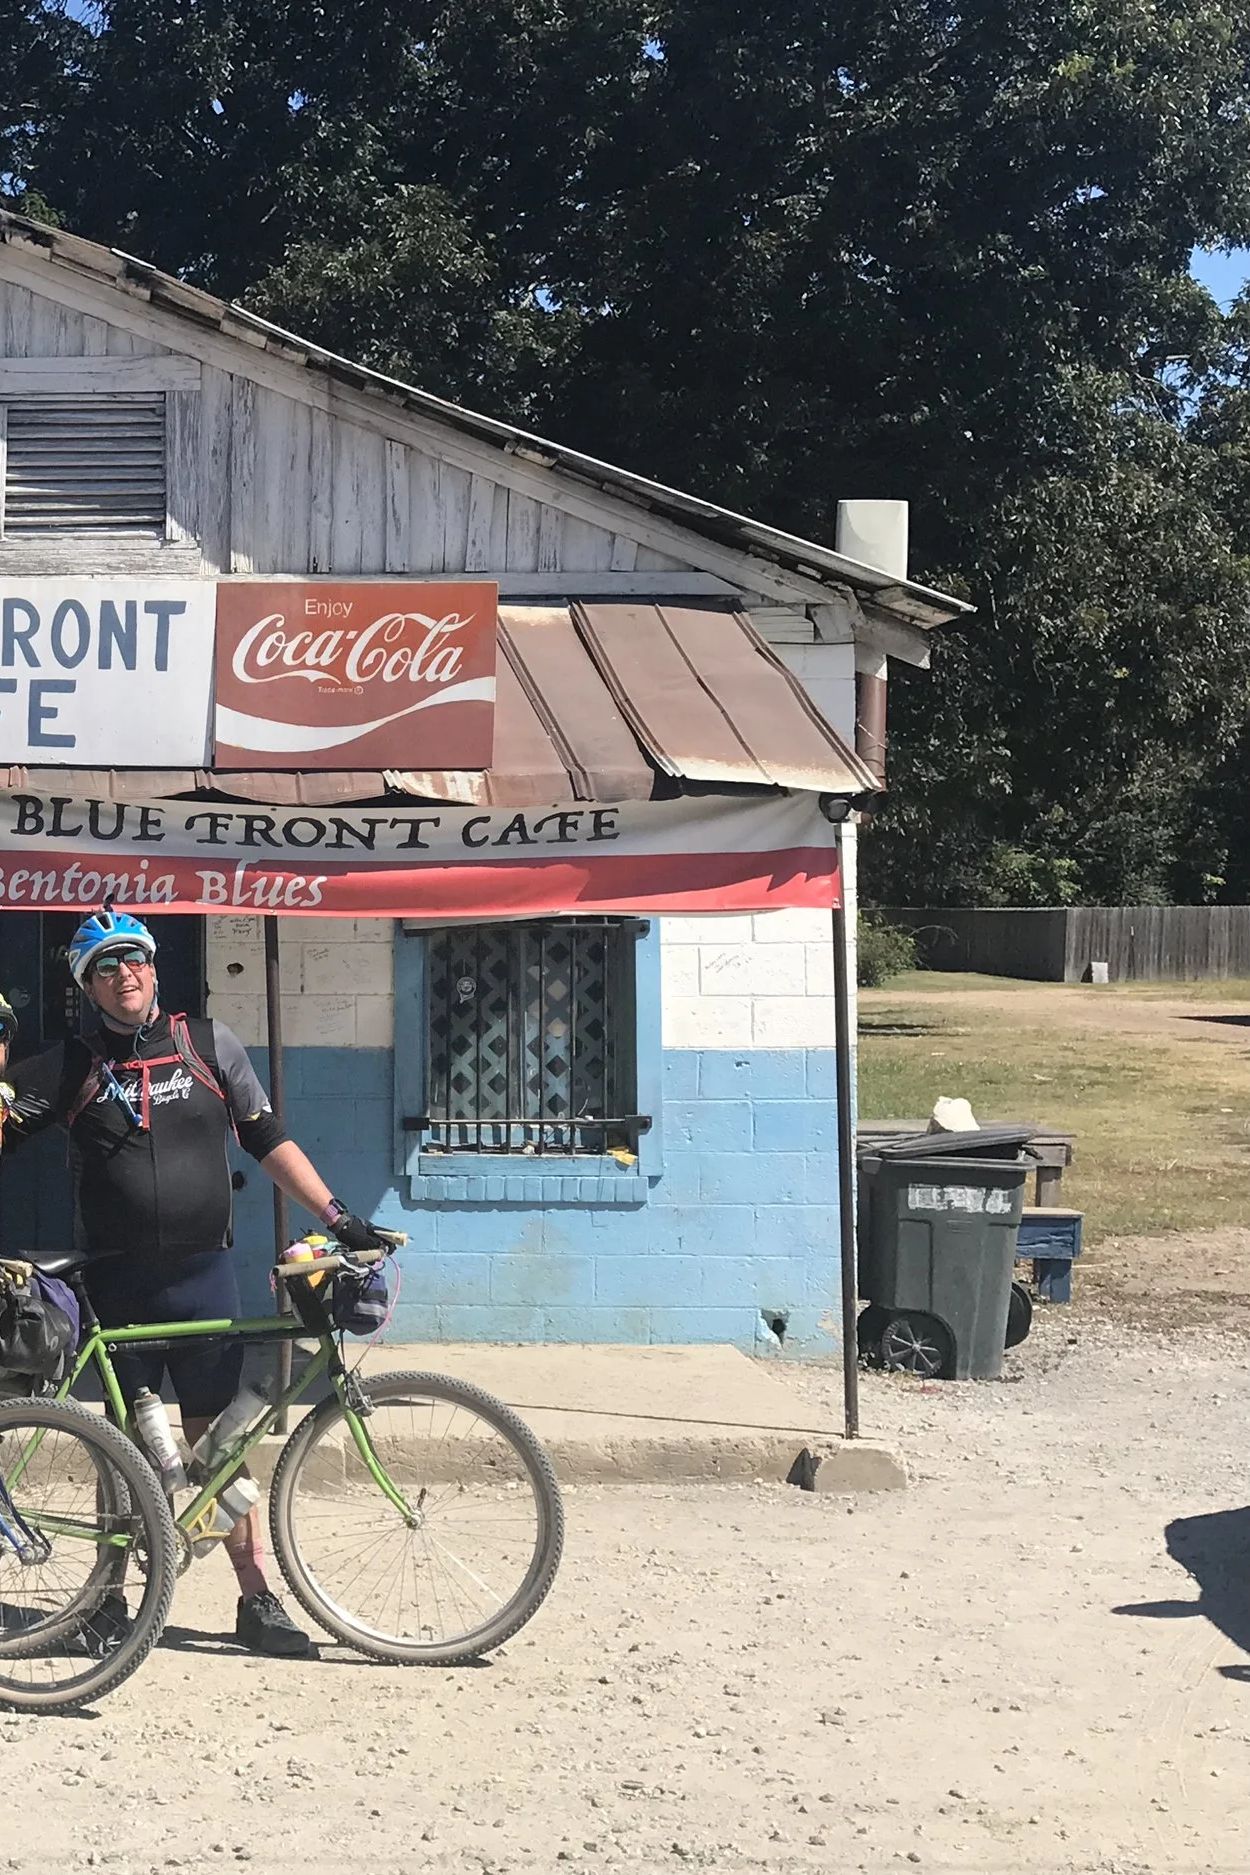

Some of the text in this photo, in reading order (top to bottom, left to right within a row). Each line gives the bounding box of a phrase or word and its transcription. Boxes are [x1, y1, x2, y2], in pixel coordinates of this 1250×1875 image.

[304, 598, 353, 618] Enjoy
[231, 611, 477, 685] Coca-Cola
[10, 794, 166, 841] BLUE
[185, 810, 441, 850] FRONT
[461, 808, 620, 849] CAFE
[195, 857, 328, 909] Blues
[97, 1068, 194, 1103] Milaukee
